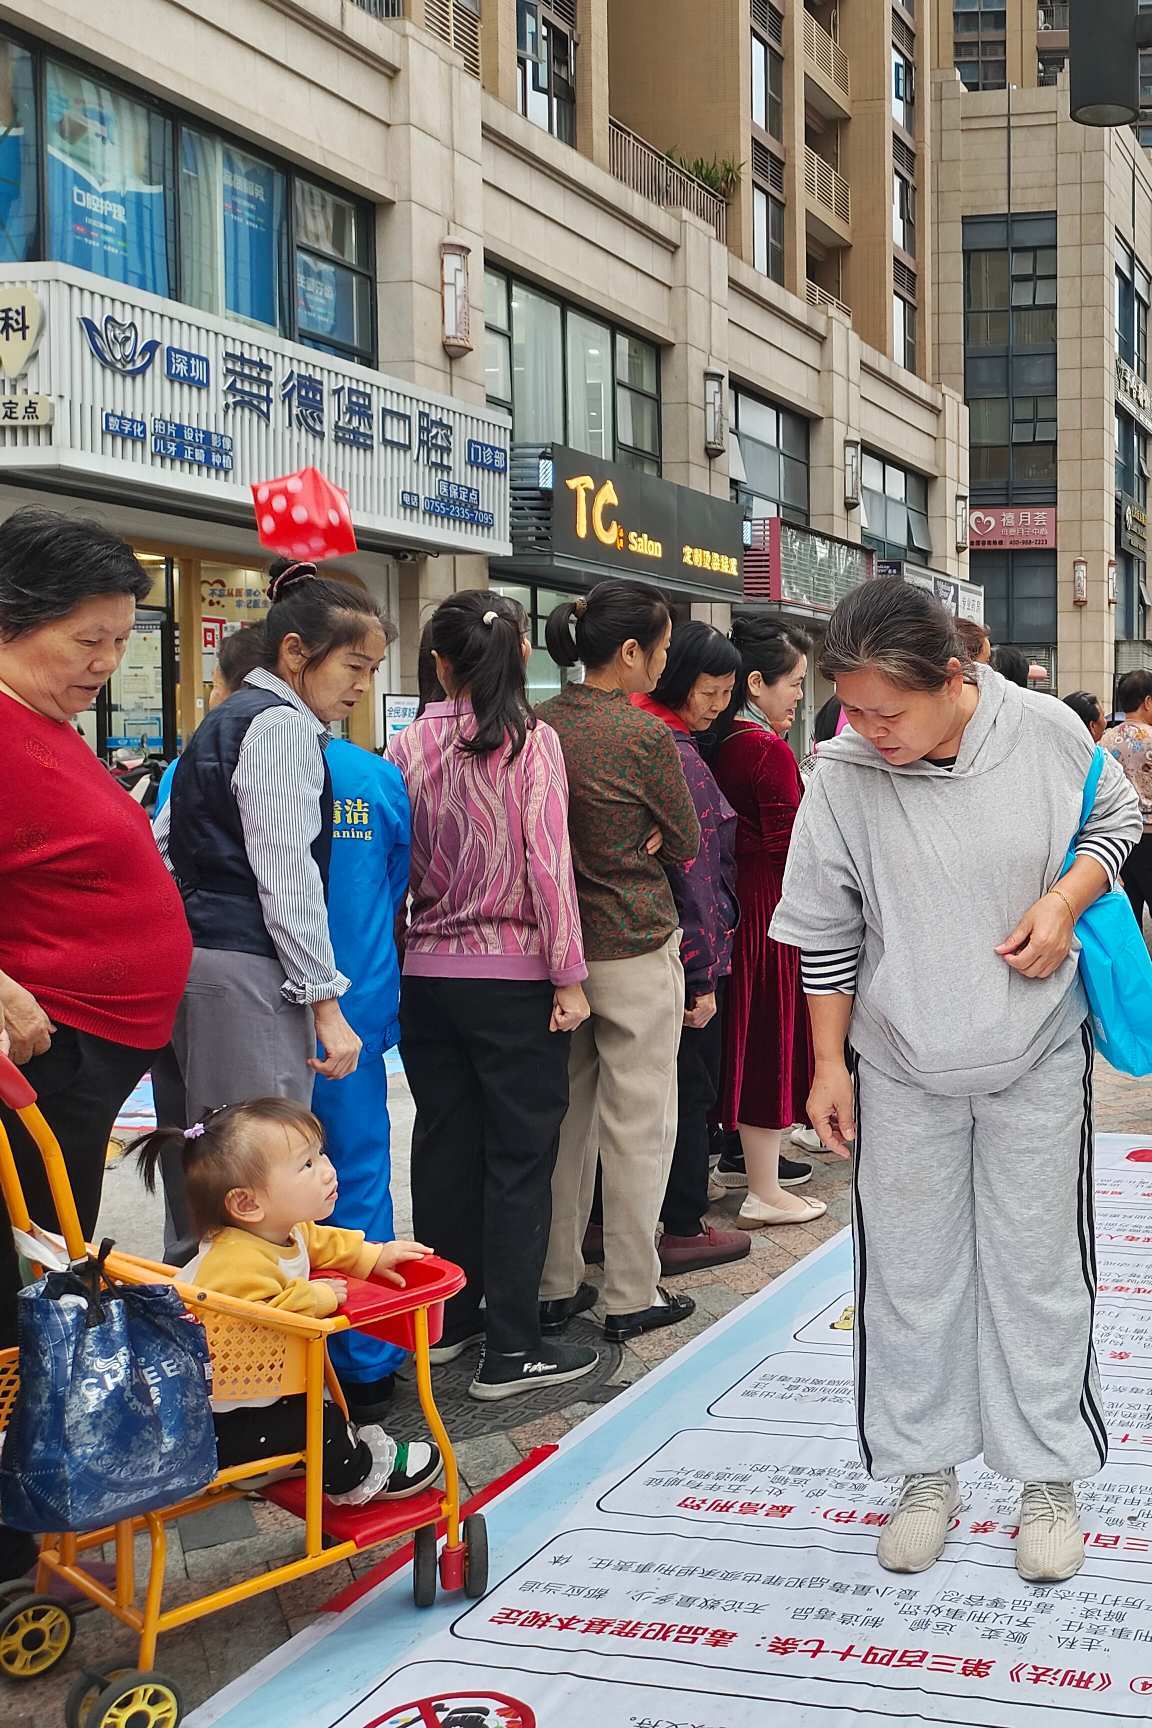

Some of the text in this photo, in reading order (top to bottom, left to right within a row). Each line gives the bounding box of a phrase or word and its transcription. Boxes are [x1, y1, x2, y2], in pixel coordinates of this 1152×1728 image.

[0, 305, 30, 341] 科
[171, 350, 208, 384] 深圳
[470, 442, 505, 469] 门诊部
[108, 416, 145, 438] 数字化
[154, 419, 233, 450] 拍片 设计 影像
[155, 438, 233, 469] 儿牙 正畸 种植
[439, 480, 479, 505] 医保定点
[402, 493, 494, 525] 电话 0755-2335-7095
[565, 475, 619, 545] TC
[627, 531, 663, 558] Salon
[333, 827, 373, 841] aning
